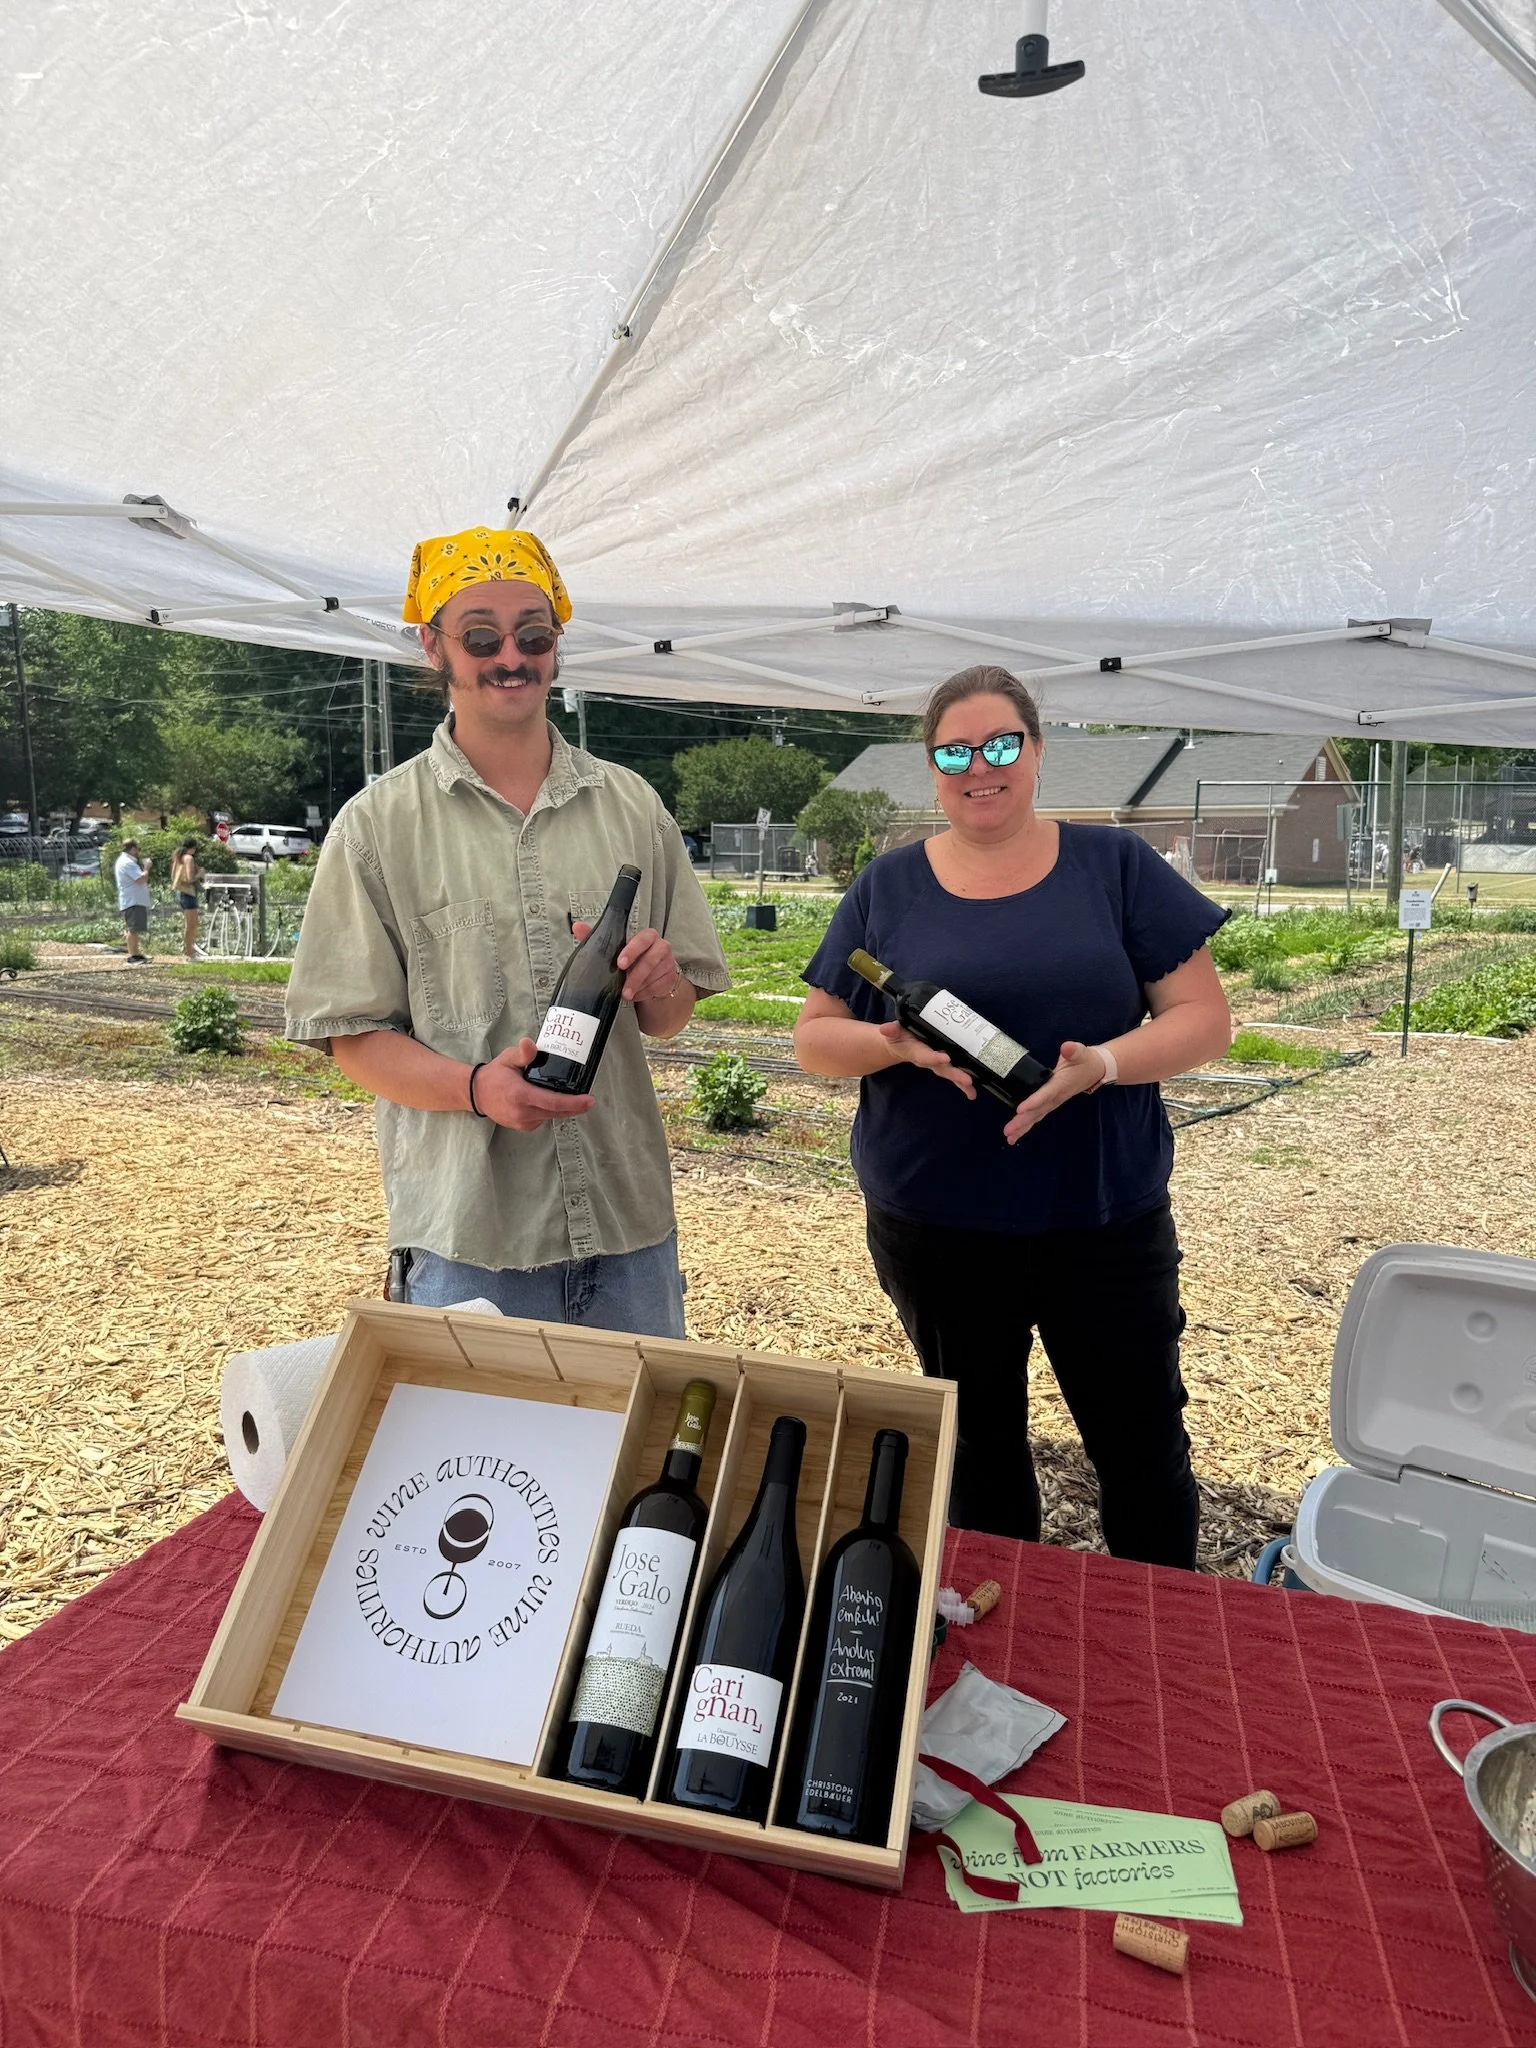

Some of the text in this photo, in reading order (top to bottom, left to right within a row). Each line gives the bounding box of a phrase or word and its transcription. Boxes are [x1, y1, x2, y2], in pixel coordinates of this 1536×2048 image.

[547, 1008, 575, 1026] Cari
[934, 1000, 960, 1025] Jose
[544, 1024, 582, 1043] gnan
[394, 1543, 427, 1555] ESTD
[488, 1559, 521, 1570] 2007
[612, 1544, 661, 1579] Jose
[619, 1569, 671, 1605] Galo
[615, 1622, 642, 1633] RUEDA
[693, 1666, 745, 1699] Cari
[837, 1691, 858, 1704] 2021
[693, 1696, 761, 1731] gnan
[697, 1733, 758, 1755] LA BOUYSSE
[805, 1788, 852, 1803] EDELBAUER
[806, 1779, 853, 1795] CHRISTOPH
[950, 1840, 1205, 1869] wine fm FARMERS
[1007, 1862, 1175, 1890] NOT factories
